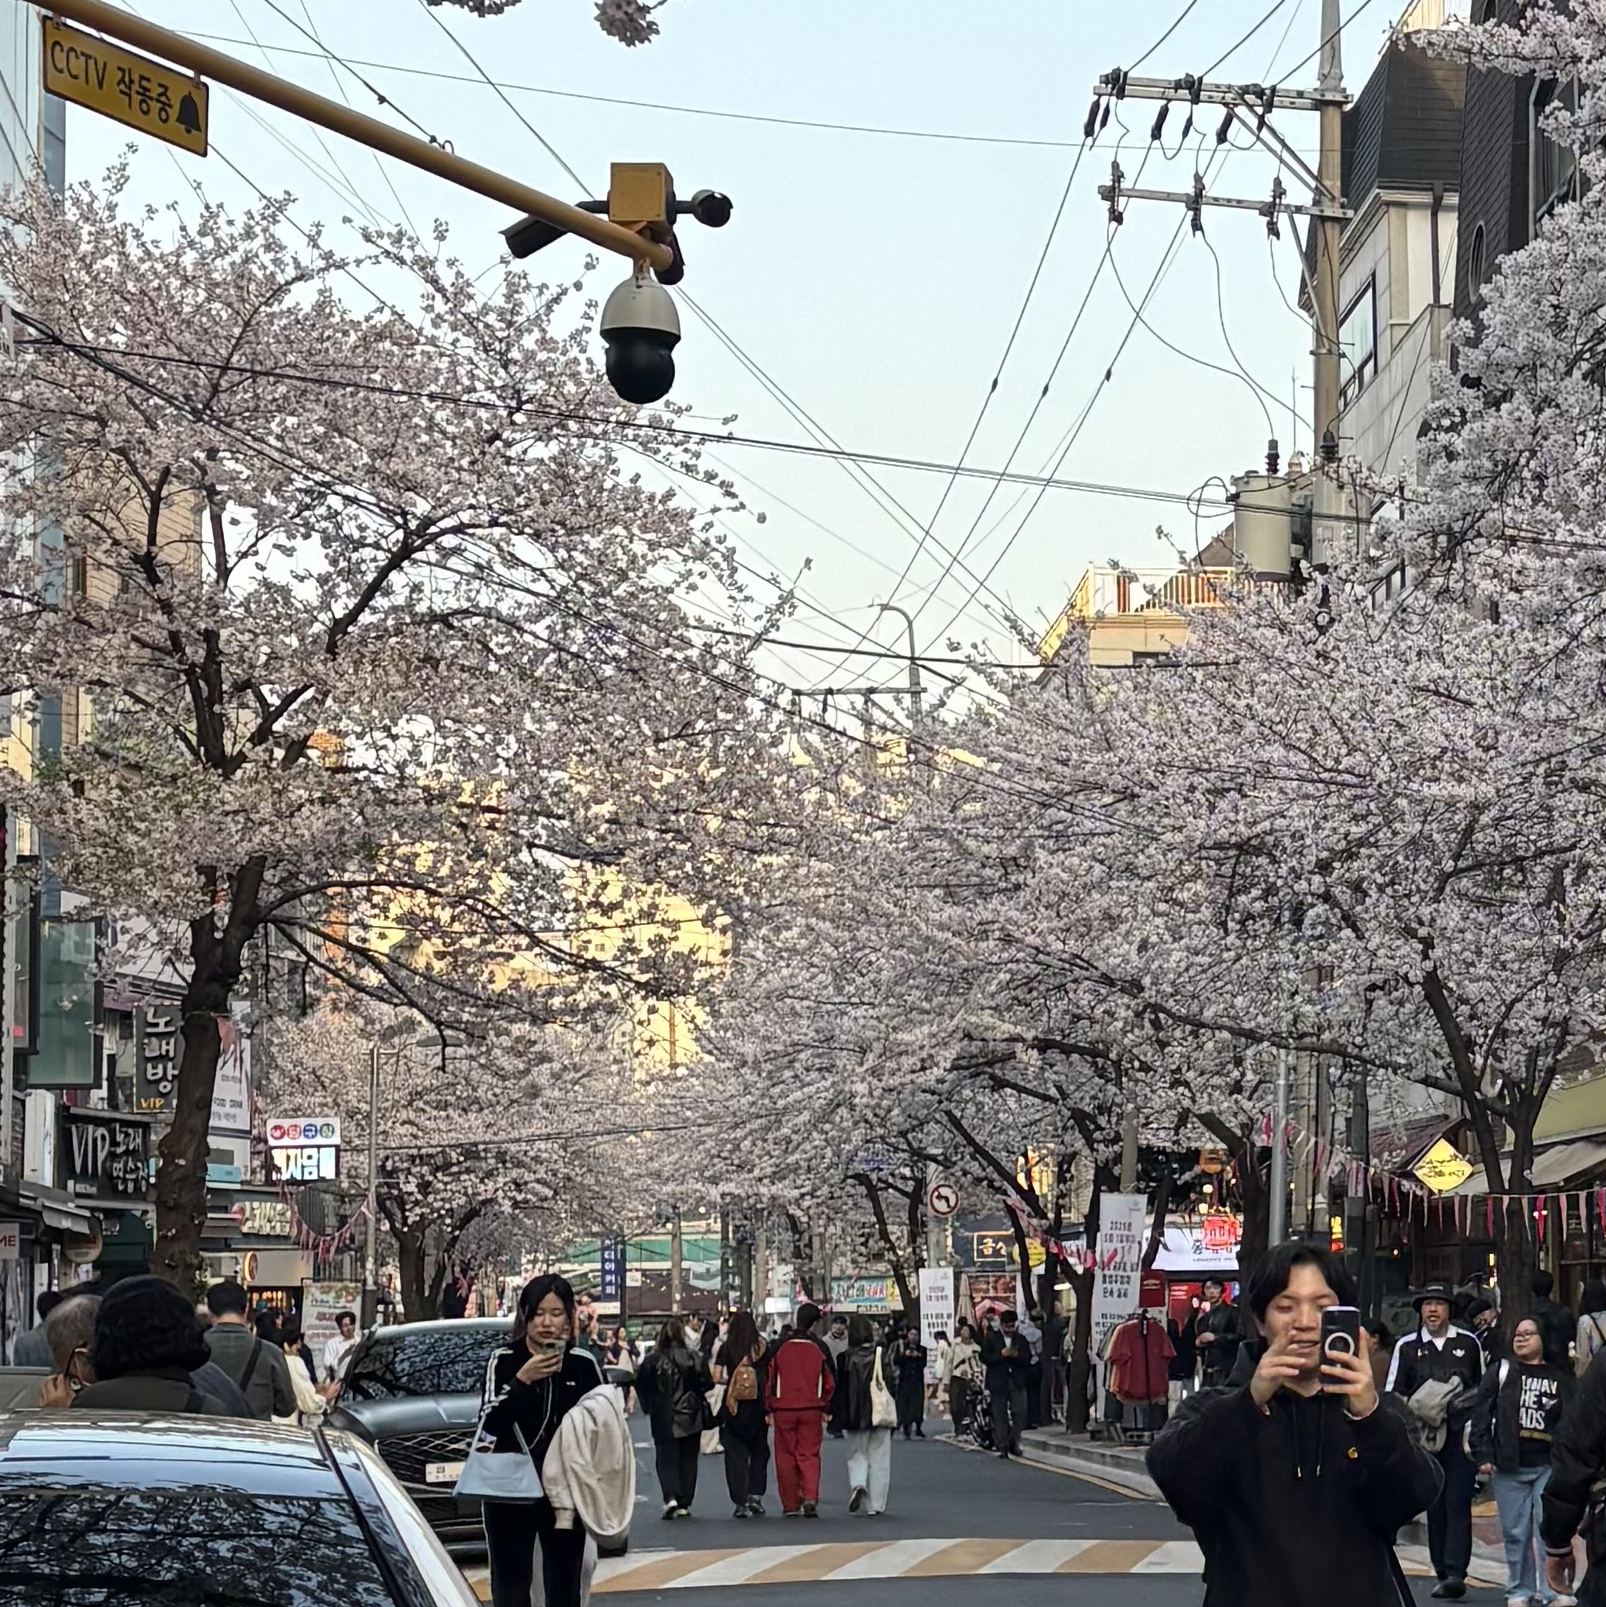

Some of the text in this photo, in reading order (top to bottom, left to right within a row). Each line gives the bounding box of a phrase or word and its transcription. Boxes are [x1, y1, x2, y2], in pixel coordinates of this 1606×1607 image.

[50, 40, 173, 124] CCTV 작동중
[143, 1006, 180, 1094] 노래방
[71, 1124, 109, 1177] VIP
[110, 1123, 142, 1154] 노래
